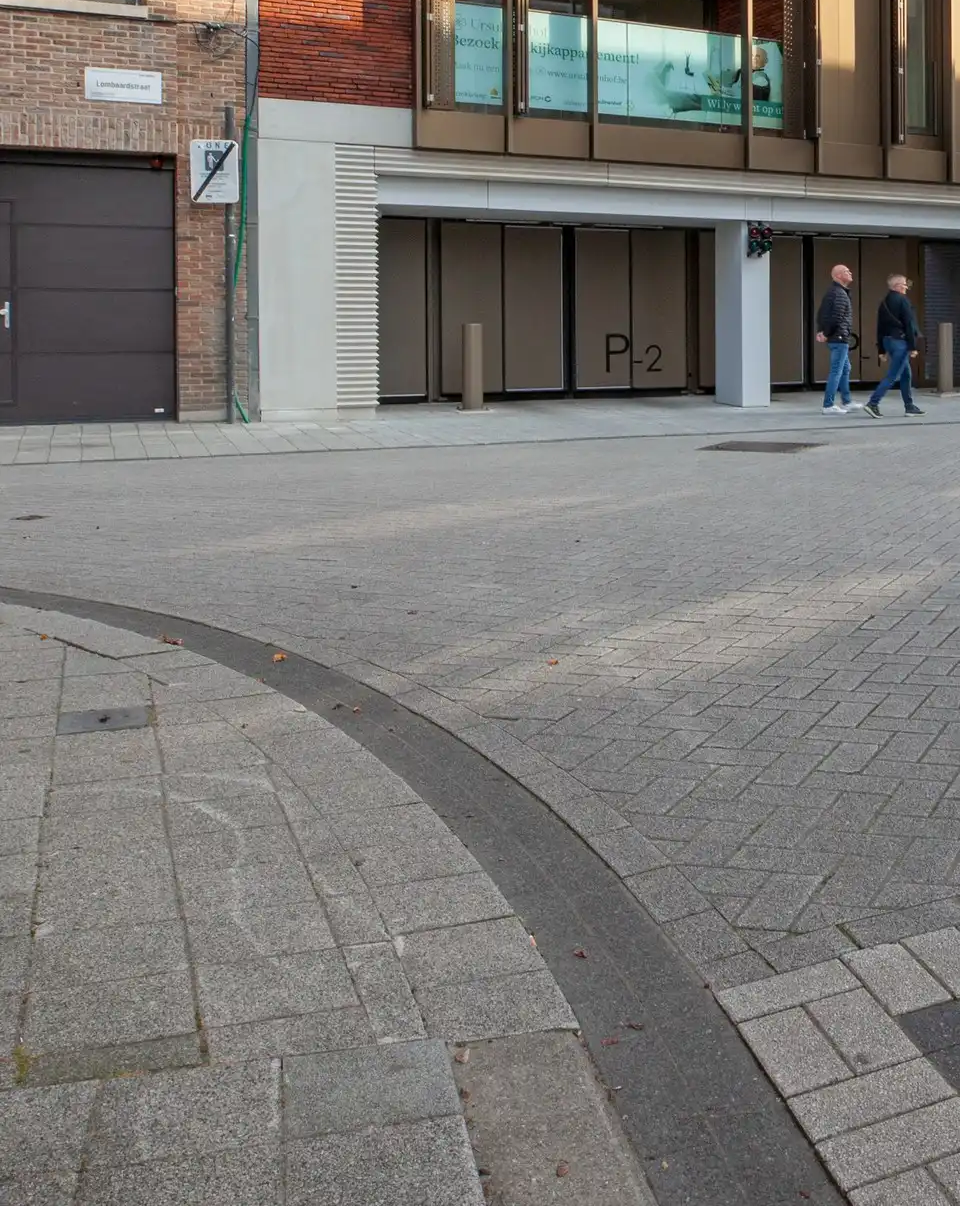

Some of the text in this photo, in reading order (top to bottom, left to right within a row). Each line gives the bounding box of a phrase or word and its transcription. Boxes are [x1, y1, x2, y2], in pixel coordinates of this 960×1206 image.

[96, 80, 151, 92] Lombaardstraat
[707, 98, 732, 112] Wily
[762, 106, 774, 116] op
